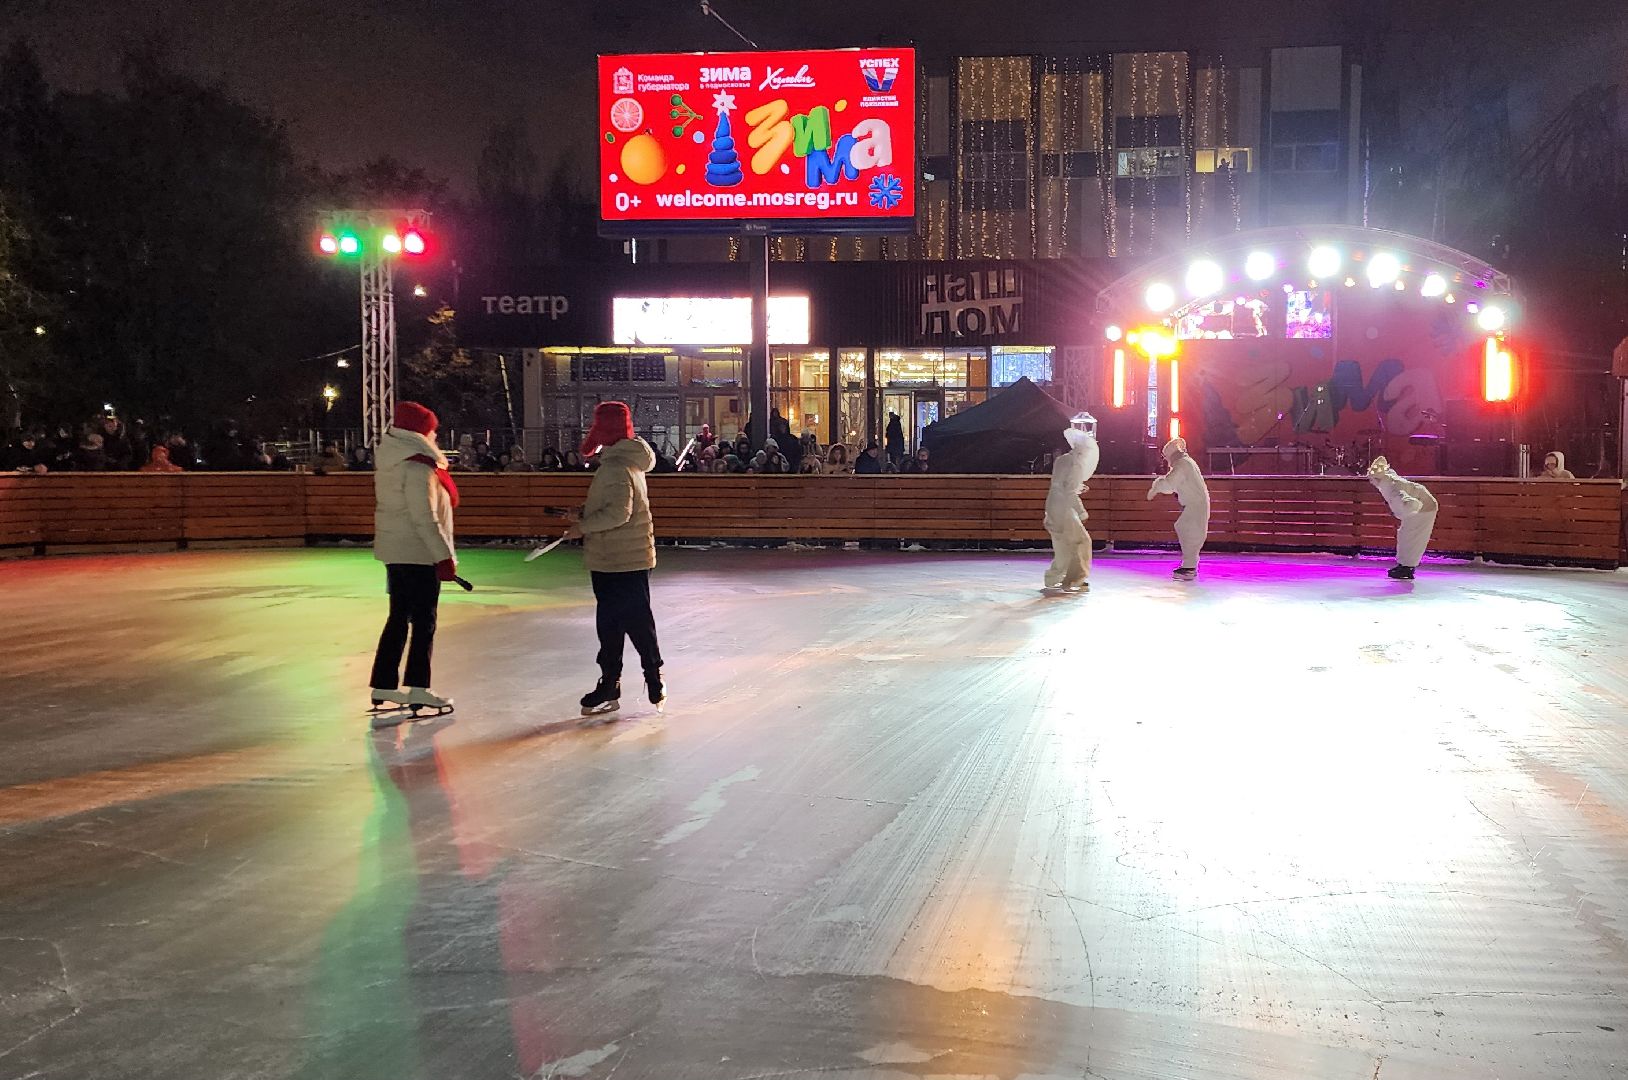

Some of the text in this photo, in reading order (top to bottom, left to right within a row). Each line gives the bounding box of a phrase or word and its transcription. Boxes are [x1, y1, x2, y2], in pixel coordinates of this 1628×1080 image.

[858, 58, 900, 68] УСПЕХ
[637, 73, 674, 82] Команда
[637, 82, 690, 92] губернатора
[615, 192, 642, 212] 0+
[656, 190, 858, 210] welcome.mosreg.ru
[480, 295, 569, 320] театр
